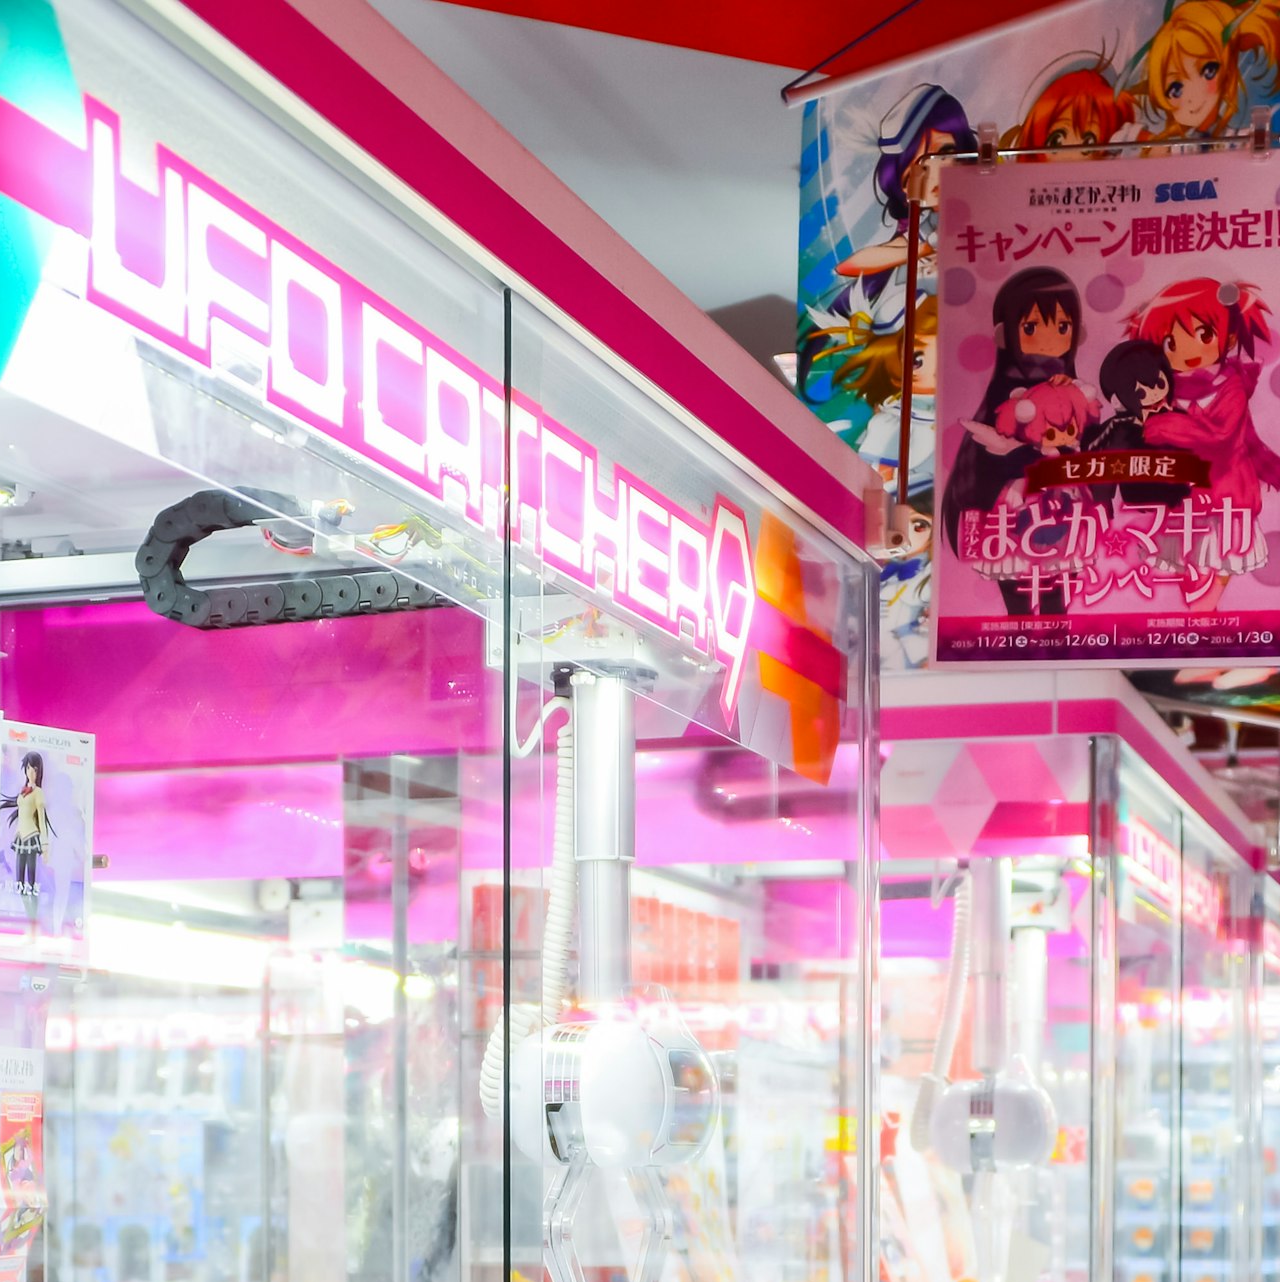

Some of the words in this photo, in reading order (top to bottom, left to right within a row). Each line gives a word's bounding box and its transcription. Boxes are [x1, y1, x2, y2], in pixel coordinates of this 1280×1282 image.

[1154, 180, 1218, 205] SEGA
[90, 112, 346, 432] UFO
[1016, 560, 1216, 610] キャンペーン
